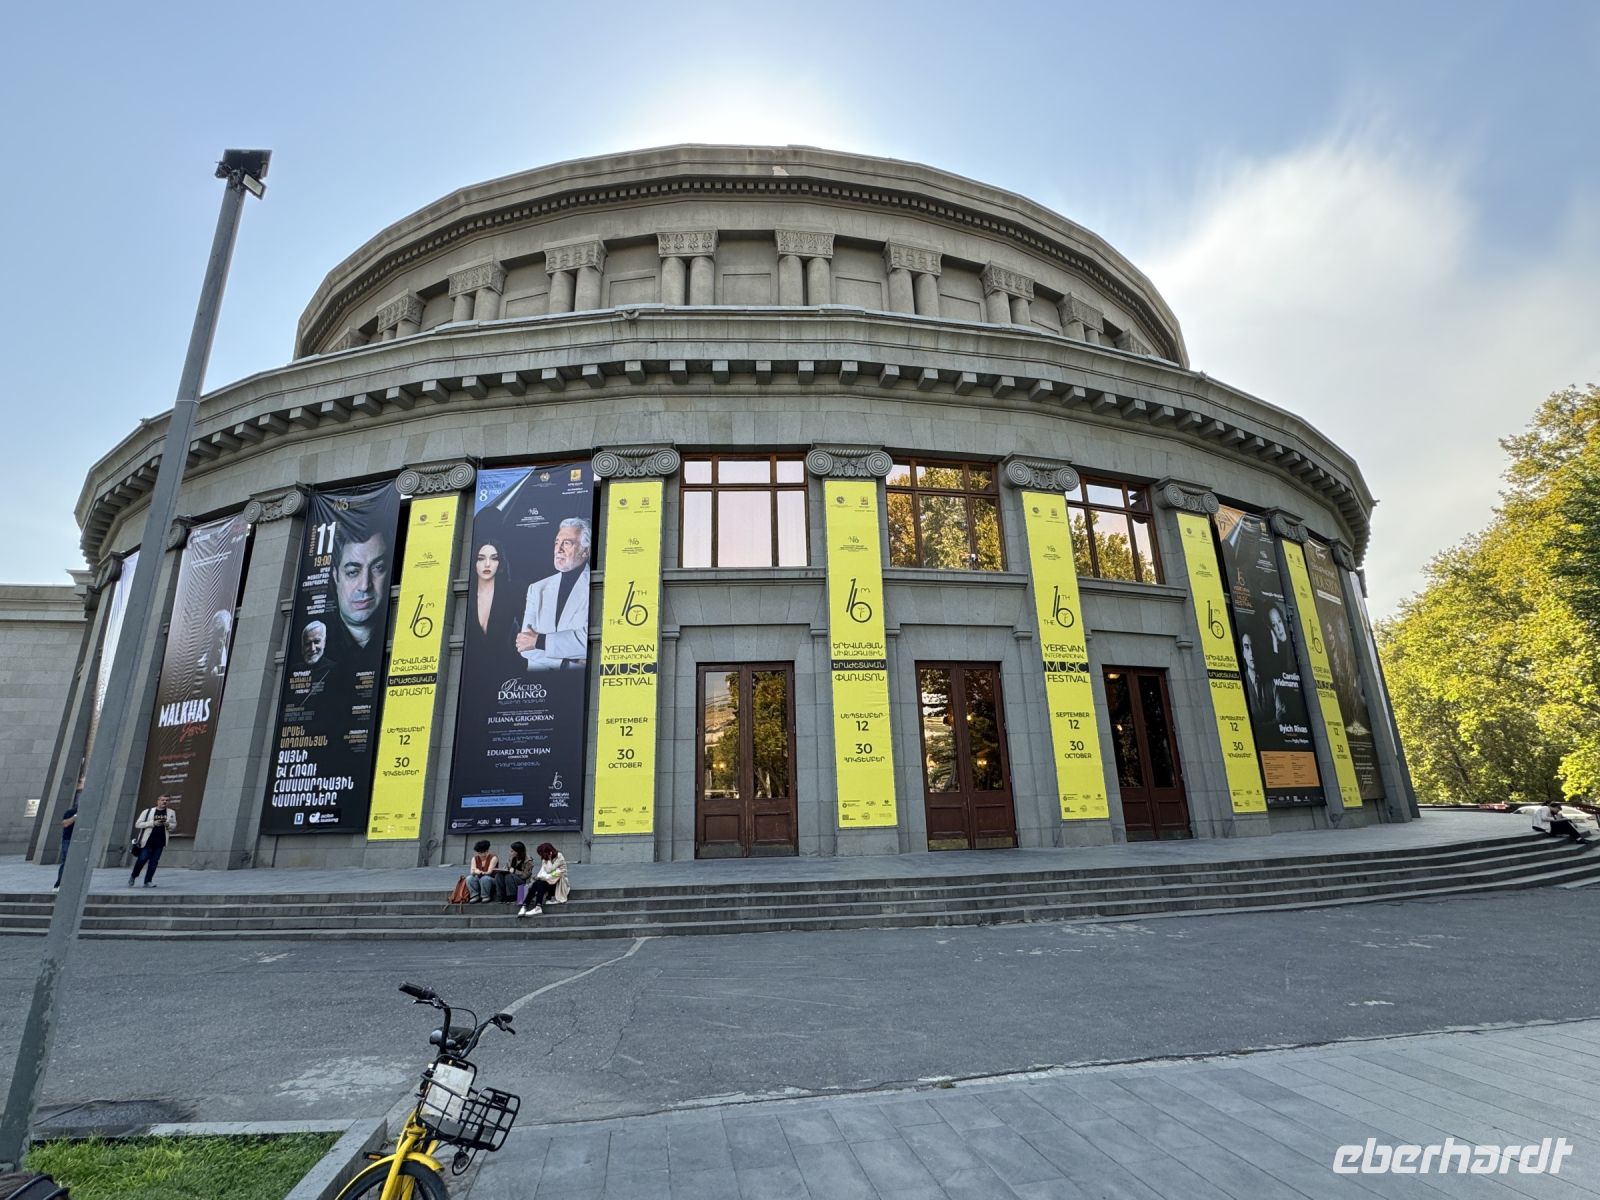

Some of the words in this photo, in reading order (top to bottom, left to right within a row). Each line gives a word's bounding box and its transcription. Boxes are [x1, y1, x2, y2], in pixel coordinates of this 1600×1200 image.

[479, 489, 488, 501] 8
[317, 522, 336, 555] 11
[314, 555, 331, 567] 19:00
[621, 581, 648, 626] 16
[846, 578, 872, 623] 16
[1052, 586, 1074, 628] 16
[604, 644, 655, 653] YEREVAN
[1043, 644, 1085, 653] YEREVAN
[603, 663, 654, 675] MUSIC
[1046, 662, 1088, 672] MUSIC
[602, 677, 653, 687] FESTIVAL
[834, 673, 885, 681] ՓԱՌԱՏՈՆ
[1047, 674, 1088, 683] FESTIVAL
[1273, 679, 1299, 688] Widmann
[497, 689, 547, 700] DOMINGO
[158, 698, 211, 728] MALKHAS
[488, 716, 514, 725] JULIANA
[515, 714, 555, 723] GRIGORYAN
[1069, 720, 1080, 729] 12
[856, 720, 869, 731] 12
[1230, 722, 1239, 731] 12
[620, 726, 633, 736] 12
[399, 735, 411, 745] 12
[855, 743, 873, 754] 30
[1069, 741, 1084, 751] 30
[1232, 741, 1243, 751] 30
[516, 747, 551, 756] TOPCHJAN
[617, 749, 635, 760] 30
[394, 757, 410, 768] 30
